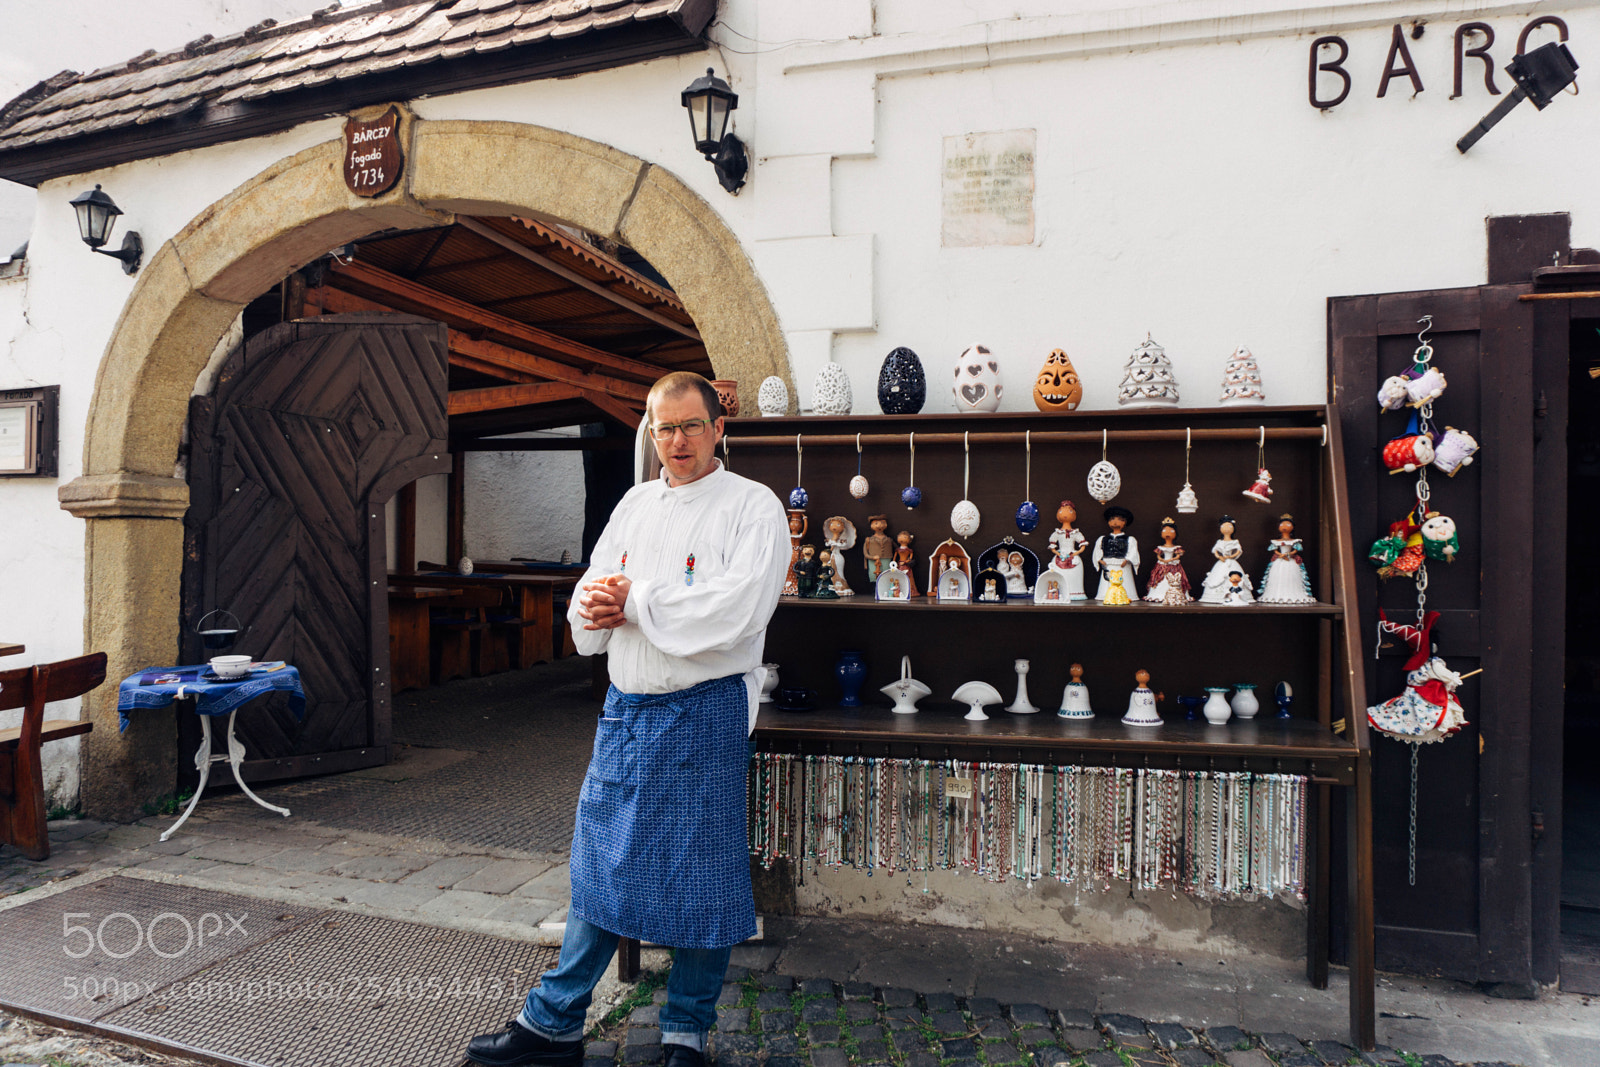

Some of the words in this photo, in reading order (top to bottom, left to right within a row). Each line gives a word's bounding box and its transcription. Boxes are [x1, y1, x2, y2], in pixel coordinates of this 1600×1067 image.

[352, 126, 391, 144] BÁRCZY
[350, 147, 382, 170] fogadó
[353, 167, 384, 187] 1734
